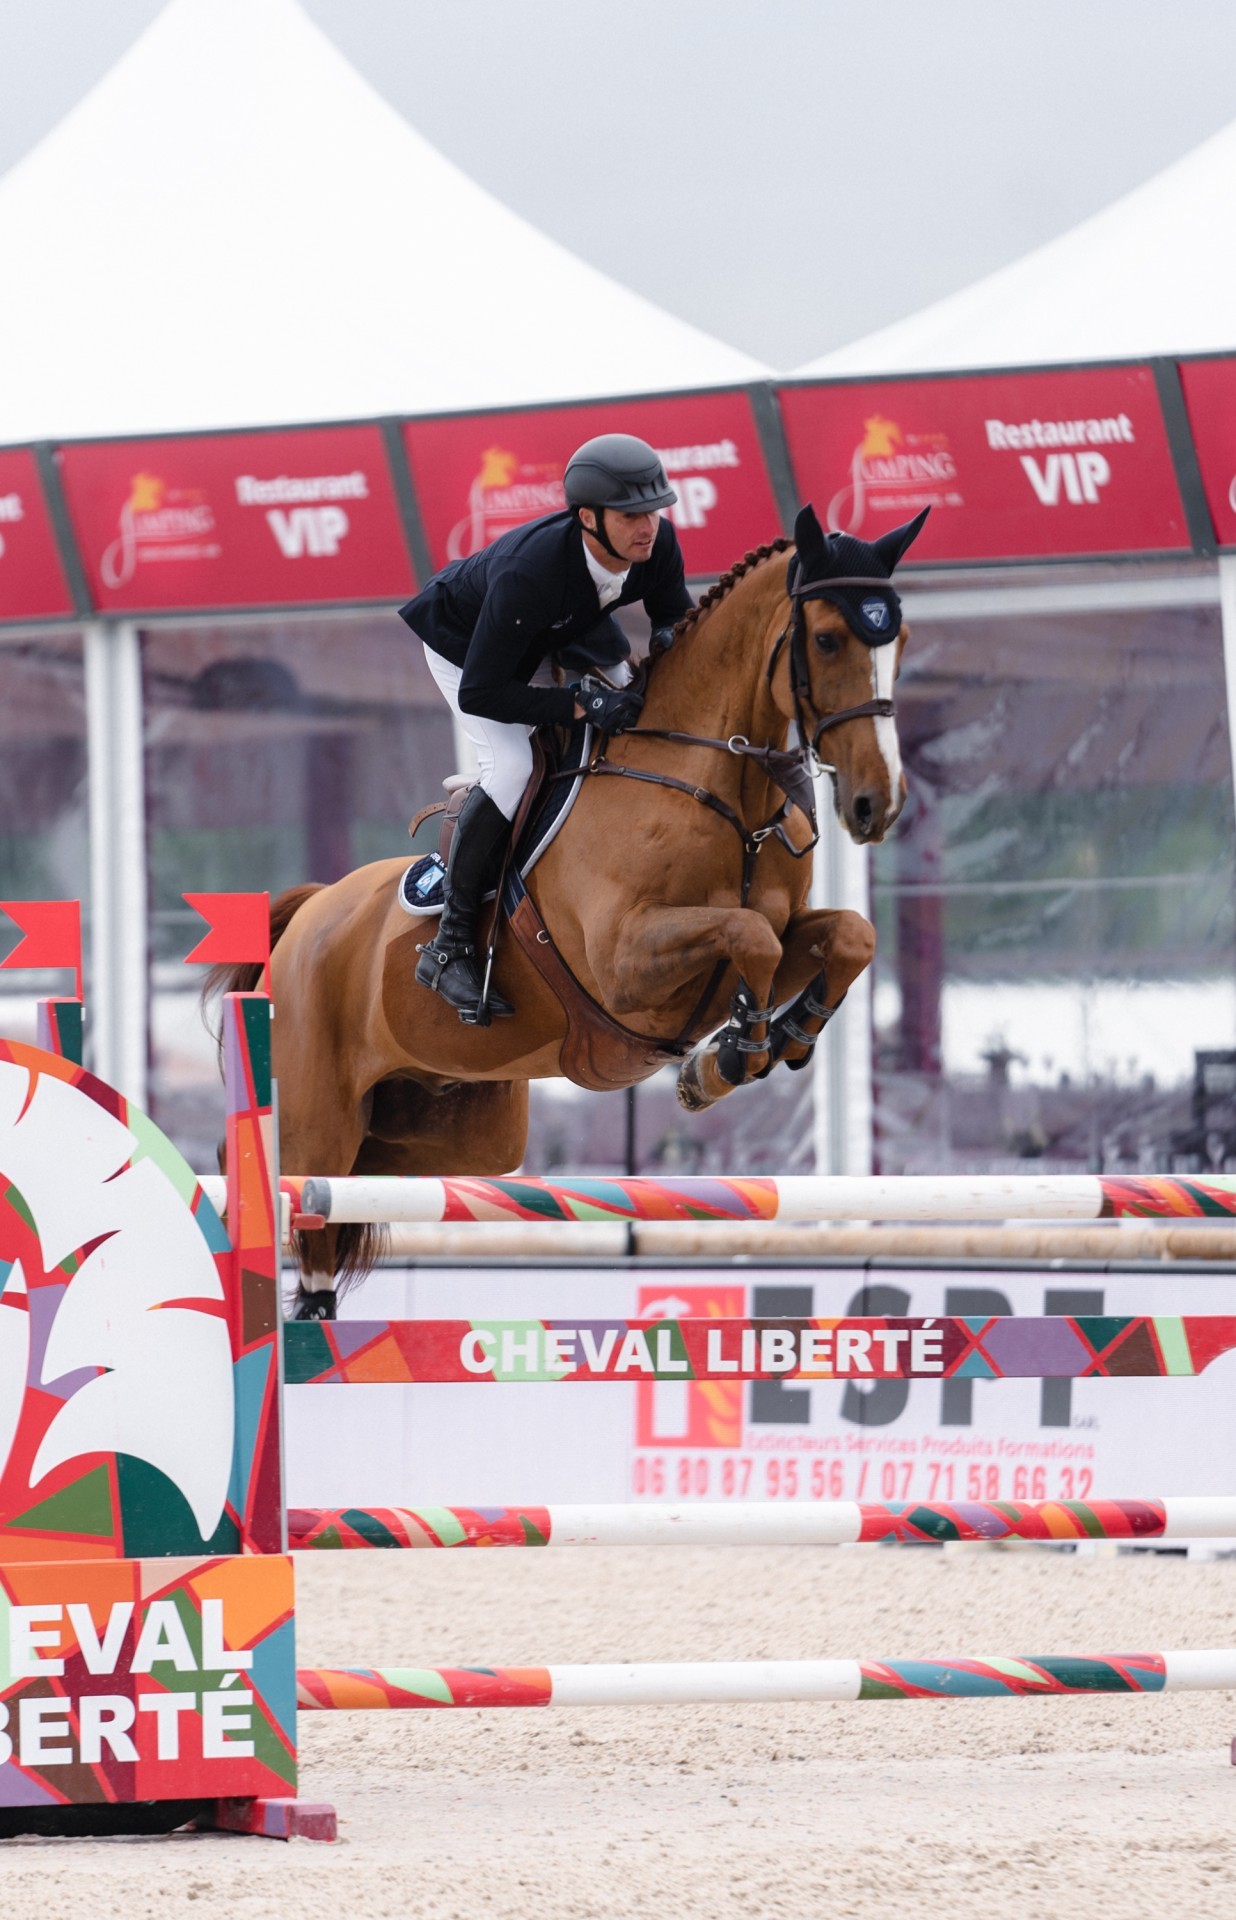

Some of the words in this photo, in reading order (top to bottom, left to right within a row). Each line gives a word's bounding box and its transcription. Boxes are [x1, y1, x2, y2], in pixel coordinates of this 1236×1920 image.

[985, 413, 1135, 450] Restaurant
[235, 470, 370, 506] Restaurant
[659, 477, 717, 529] IP
[1019, 451, 1111, 506] VIP
[266, 506, 349, 558] VIP
[459, 1329, 688, 1374] CHEVAL
[707, 1319, 944, 1374] LIBERTÉ
[747, 1432, 841, 1452] Extincteurs
[845, 1434, 917, 1454] Services
[922, 1435, 994, 1457] Produits
[997, 1437, 1095, 1459] Formations
[634, 1457, 664, 1496] 06
[722, 1458, 753, 1496] 87
[767, 1459, 798, 1498] 95
[812, 1459, 843, 1498] 56
[857, 1459, 869, 1499] /
[881, 1460, 914, 1500] 07
[928, 1462, 954, 1501] 71
[967, 1463, 1000, 1501] 58
[1013, 1464, 1046, 1501] 66
[1060, 1466, 1094, 1501] 32
[0, 1673, 255, 1766] ERTÉ
